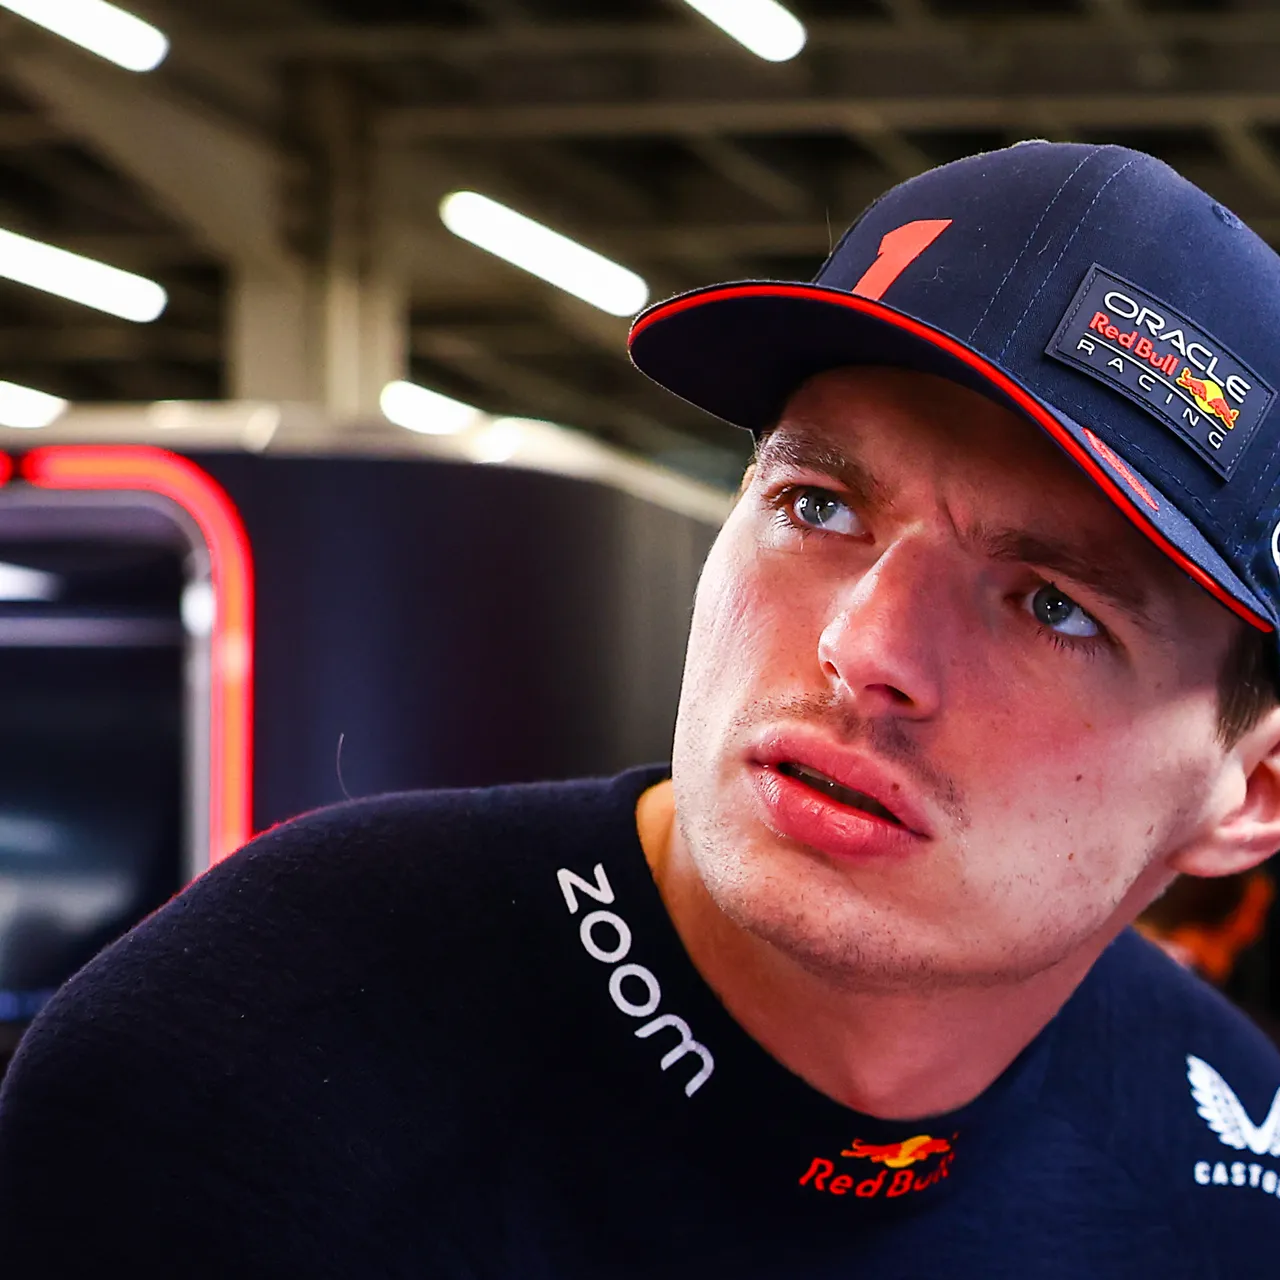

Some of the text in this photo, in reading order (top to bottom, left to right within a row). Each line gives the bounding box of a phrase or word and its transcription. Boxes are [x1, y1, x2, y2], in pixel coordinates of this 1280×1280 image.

[852, 219, 953, 300] 1
[1089, 311, 1179, 376] Red Bull
[1104, 291, 1251, 403] ORACLE
[1077, 338, 1224, 450] RACING
[556, 863, 715, 1098] zoom
[799, 1157, 888, 1197] Red
